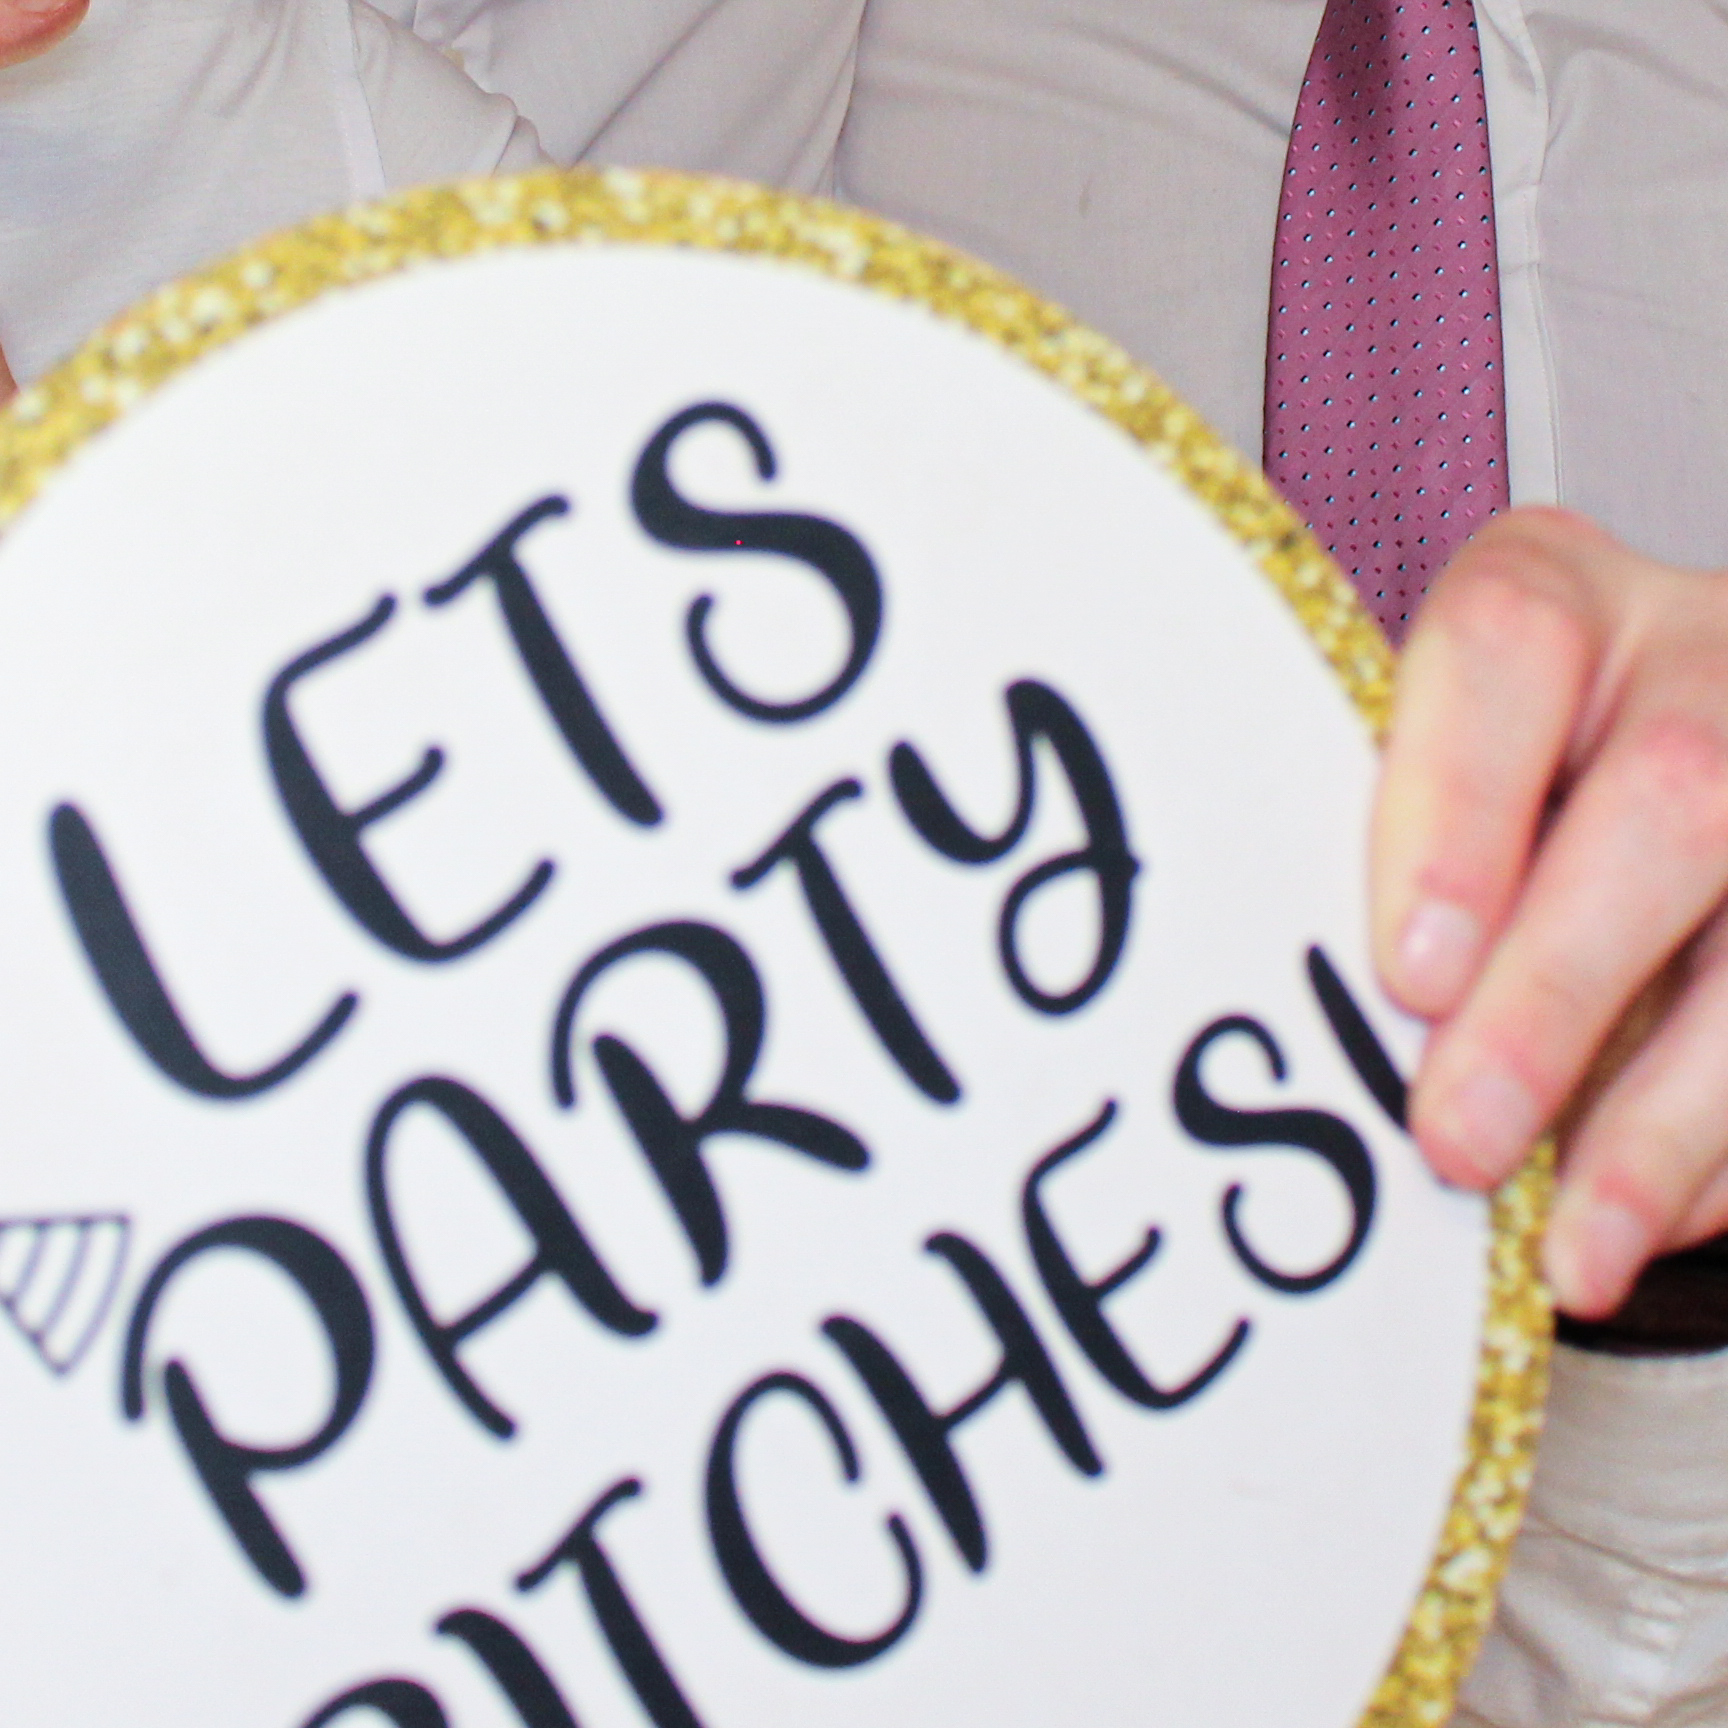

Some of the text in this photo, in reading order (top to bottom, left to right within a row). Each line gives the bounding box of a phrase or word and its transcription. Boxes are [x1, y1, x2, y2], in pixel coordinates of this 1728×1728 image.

[47, 399, 885, 1102] LETS
[119, 677, 1142, 1600] PARTY
[299, 944, 1413, 1728] TCHES!
